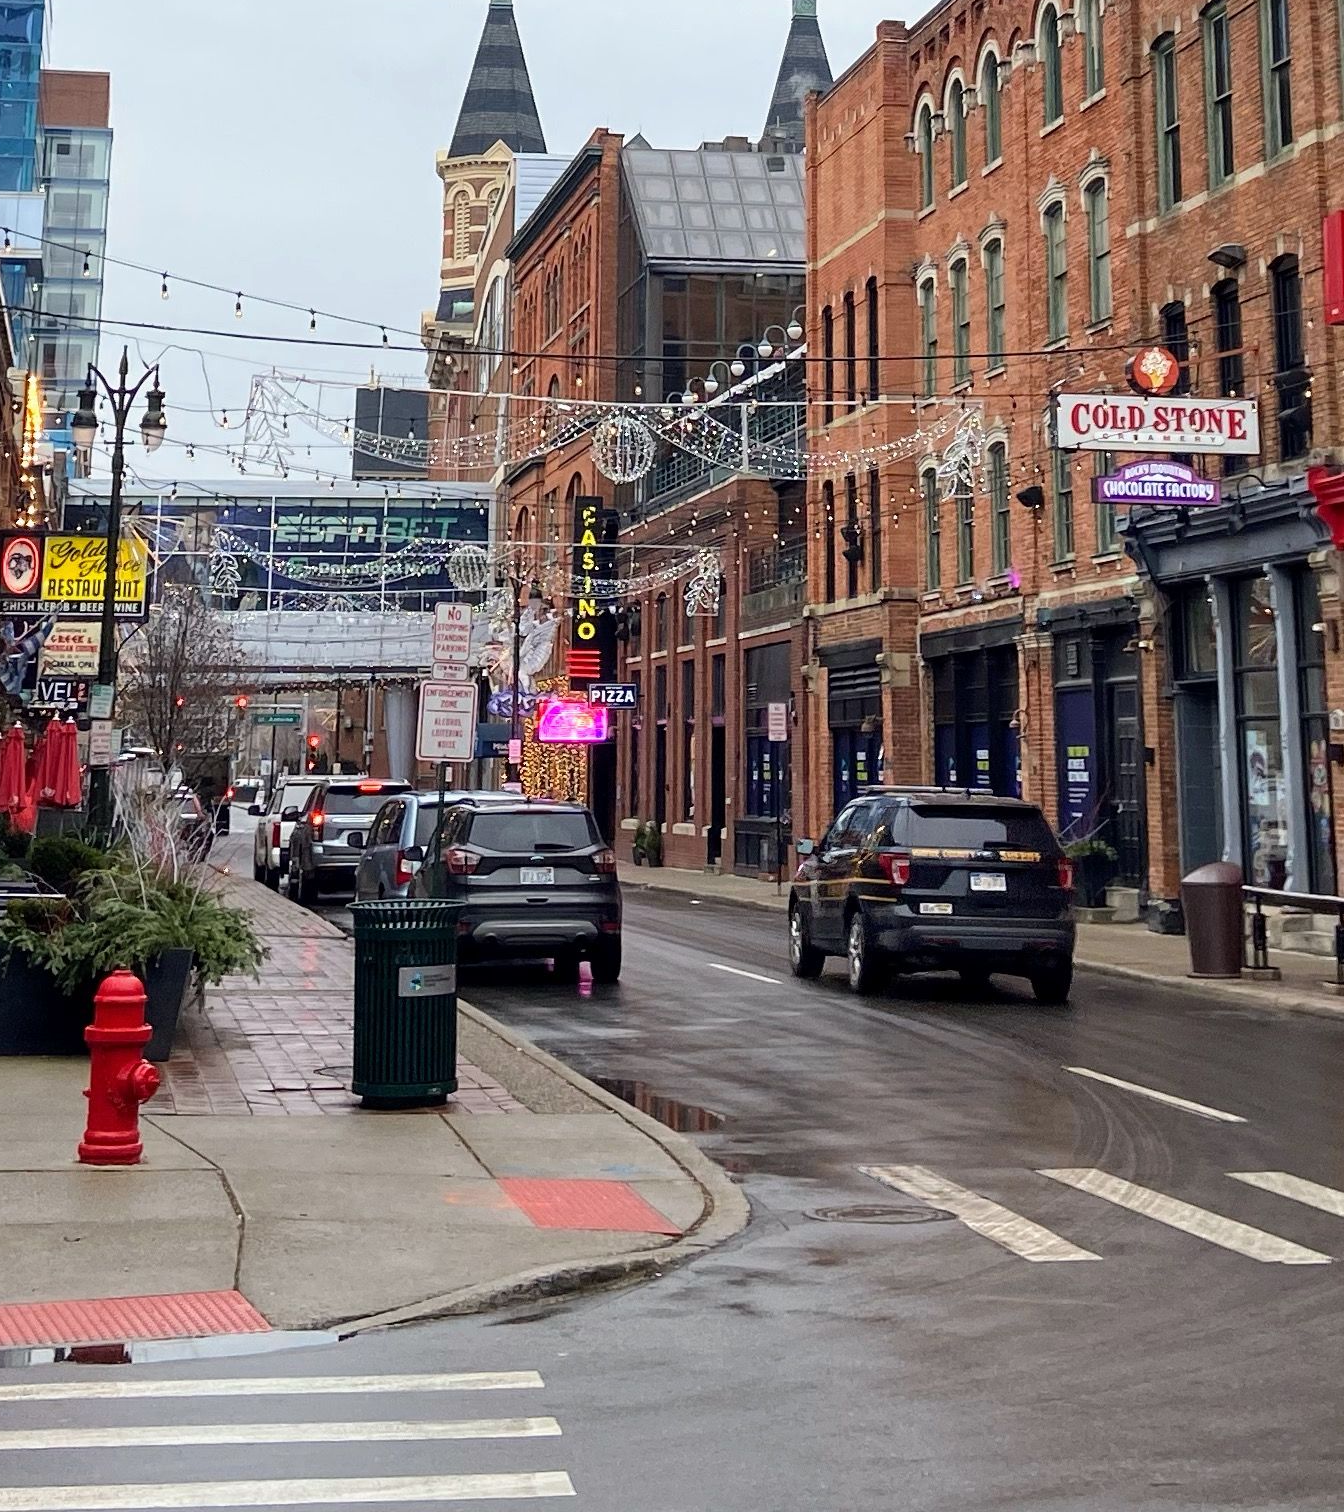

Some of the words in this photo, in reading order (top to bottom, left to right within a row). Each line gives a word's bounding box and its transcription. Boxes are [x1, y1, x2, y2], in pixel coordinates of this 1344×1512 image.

[1071, 403, 1146, 435] COLD
[1152, 406, 1248, 440] STONE
[1102, 433, 1217, 443] CRAMERY
[1103, 480, 1164, 498] CHOCOLATE
[1166, 482, 1214, 501] FACTORY
[276, 516, 377, 543] ESPN
[48, 578, 141, 597] RESTAUANT
[448, 609, 462, 620] NO
[592, 689, 635, 702] PIZZA
